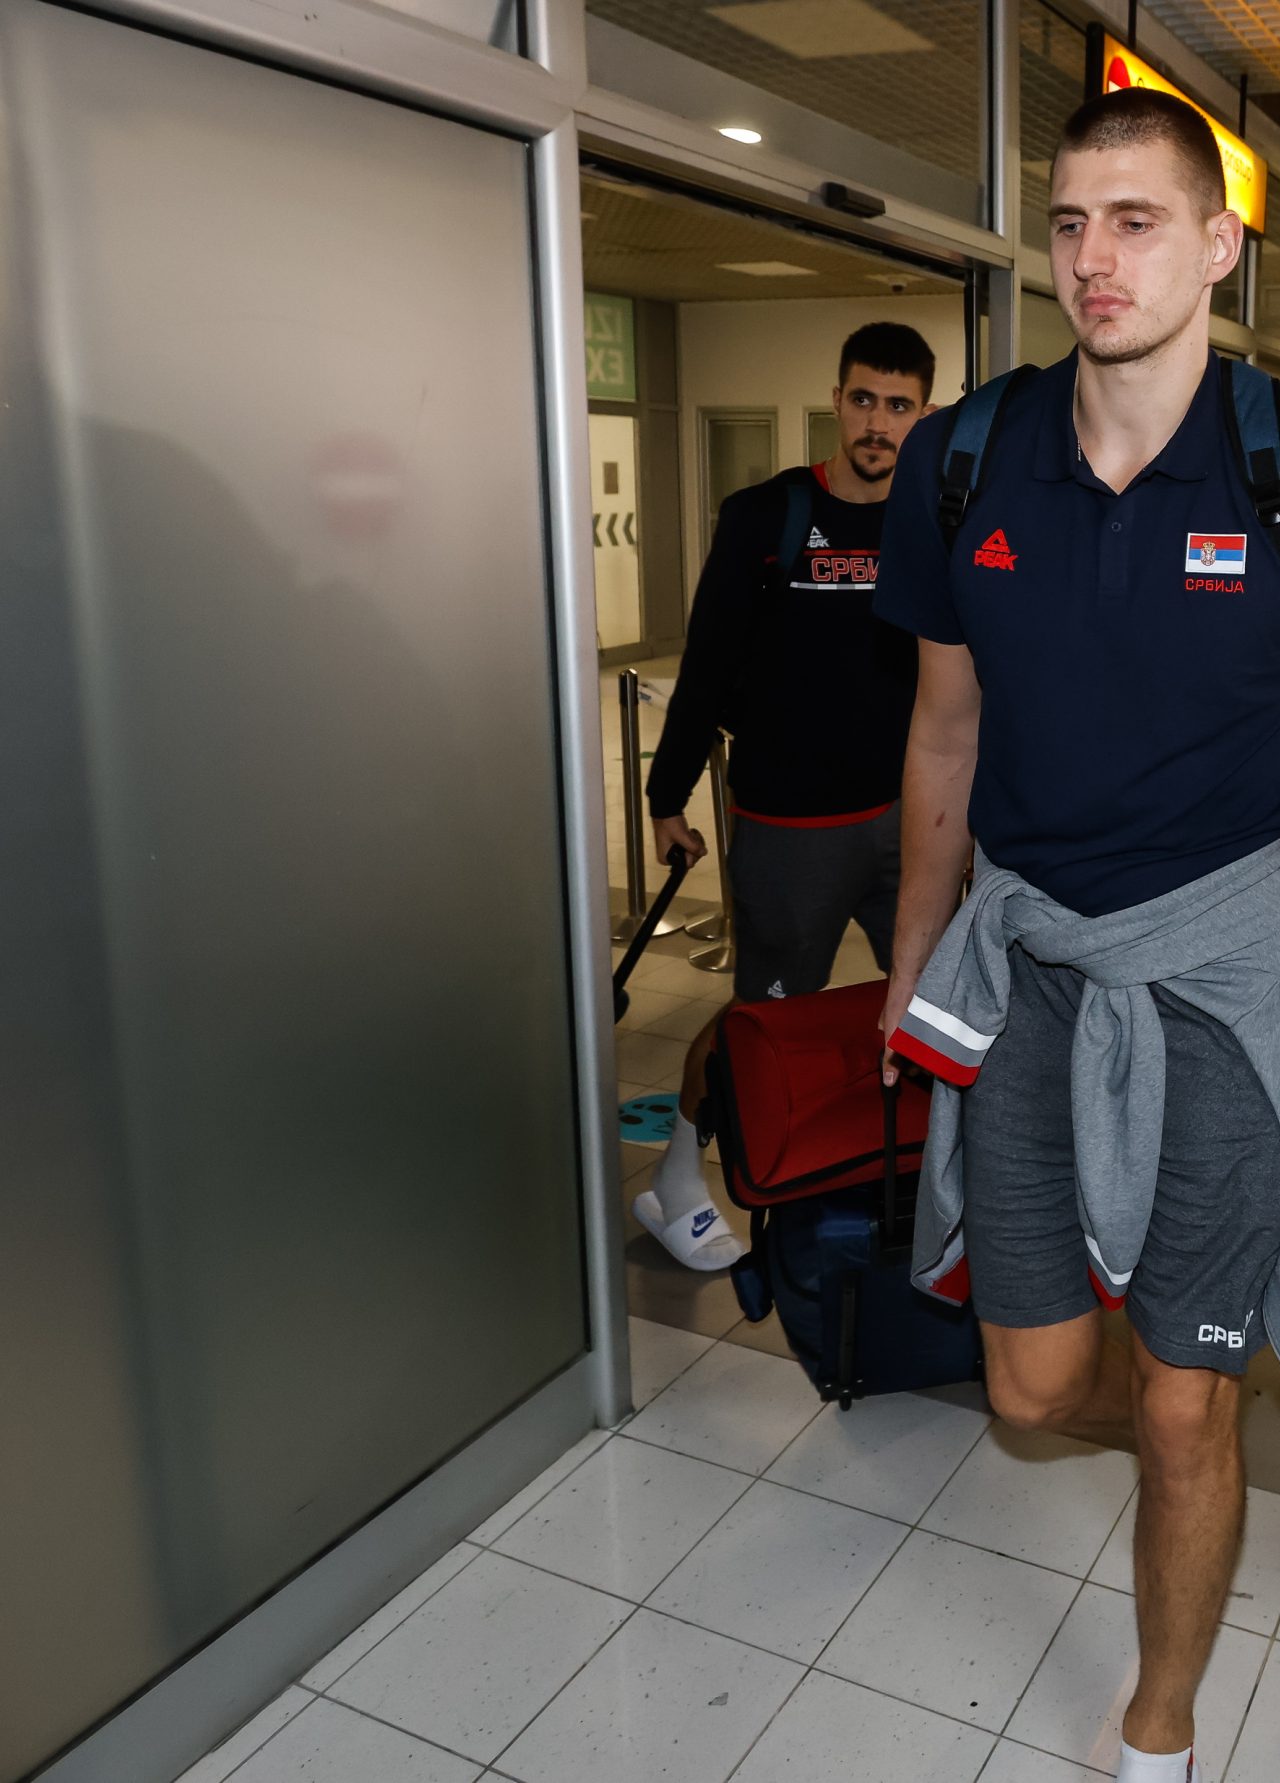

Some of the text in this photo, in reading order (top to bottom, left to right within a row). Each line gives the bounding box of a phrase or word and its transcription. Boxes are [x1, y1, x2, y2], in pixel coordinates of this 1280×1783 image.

[974, 550, 1018, 571] PEAK
[1185, 578, 1244, 594] СРБИЈА
[693, 1207, 714, 1227] NIKE
